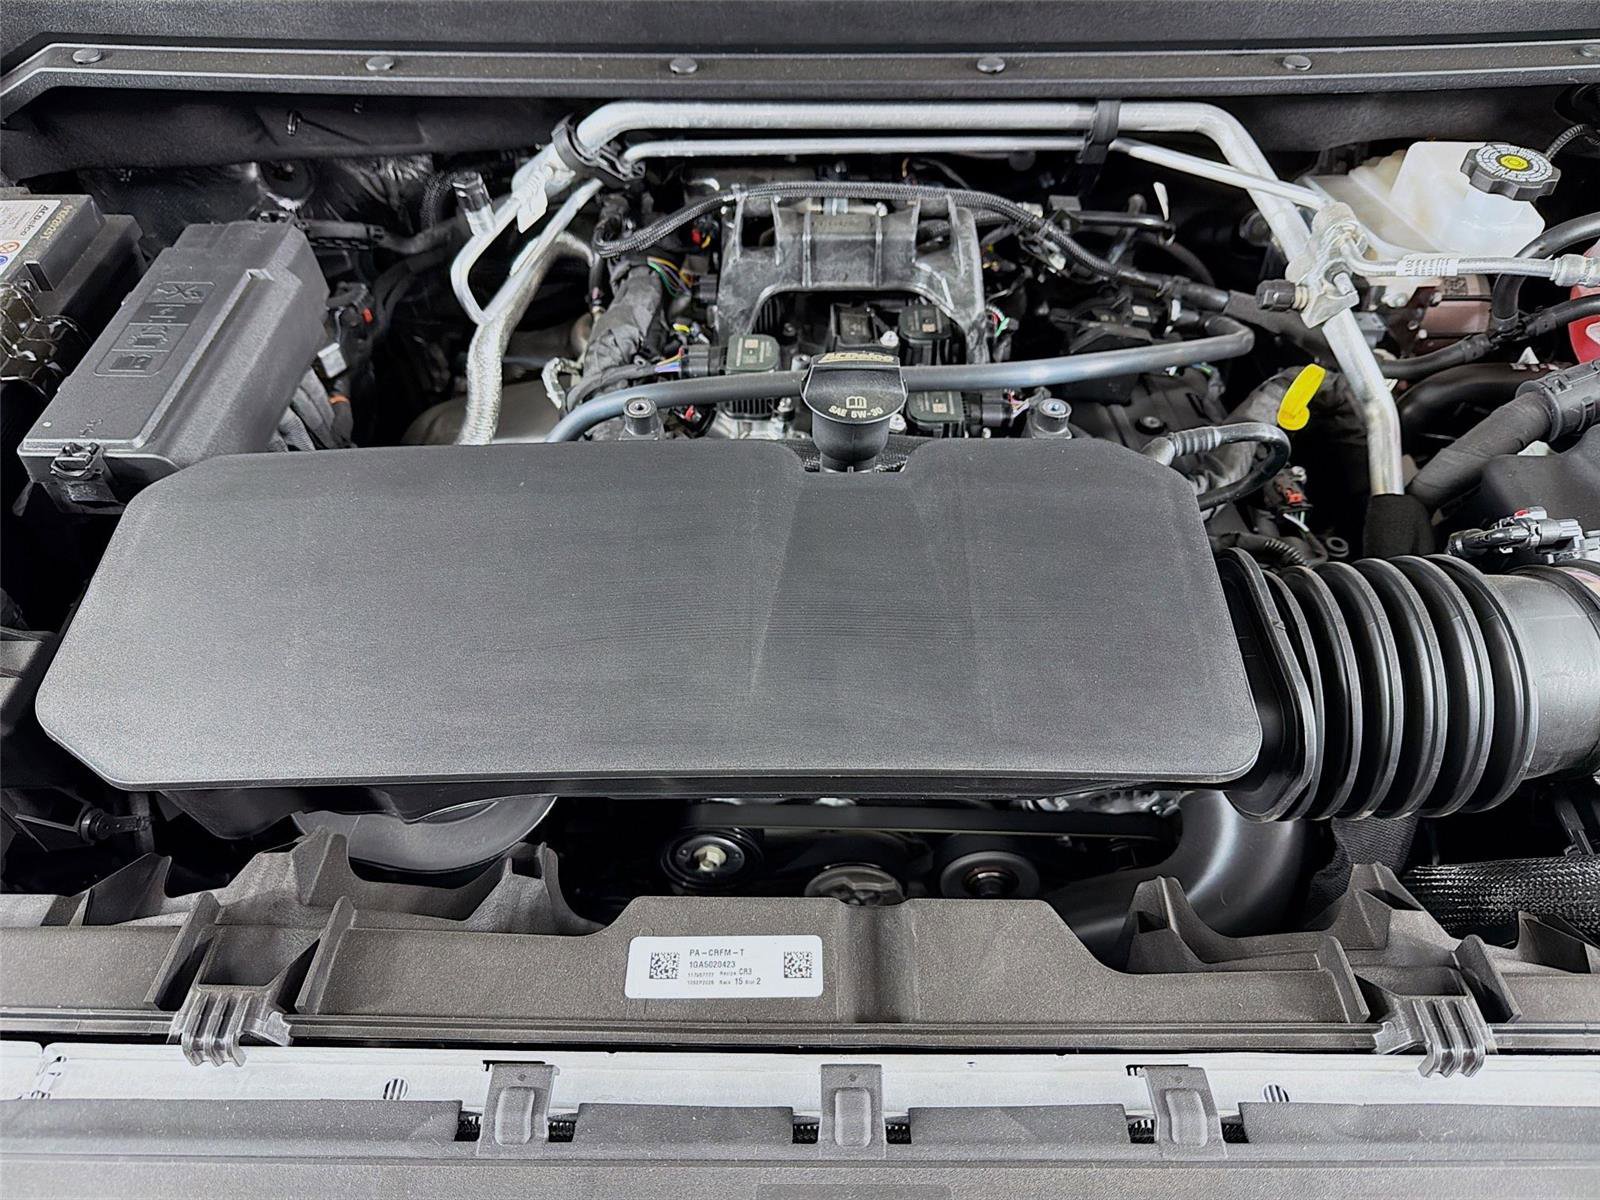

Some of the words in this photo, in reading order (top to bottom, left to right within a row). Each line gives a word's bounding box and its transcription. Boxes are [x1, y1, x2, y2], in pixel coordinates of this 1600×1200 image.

[21, 205, 49, 236] ACDelco
[828, 405, 848, 417] SAE
[850, 406, 884, 418] 5W-30
[735, 977, 743, 985] 15
[756, 977, 761, 985] 2
